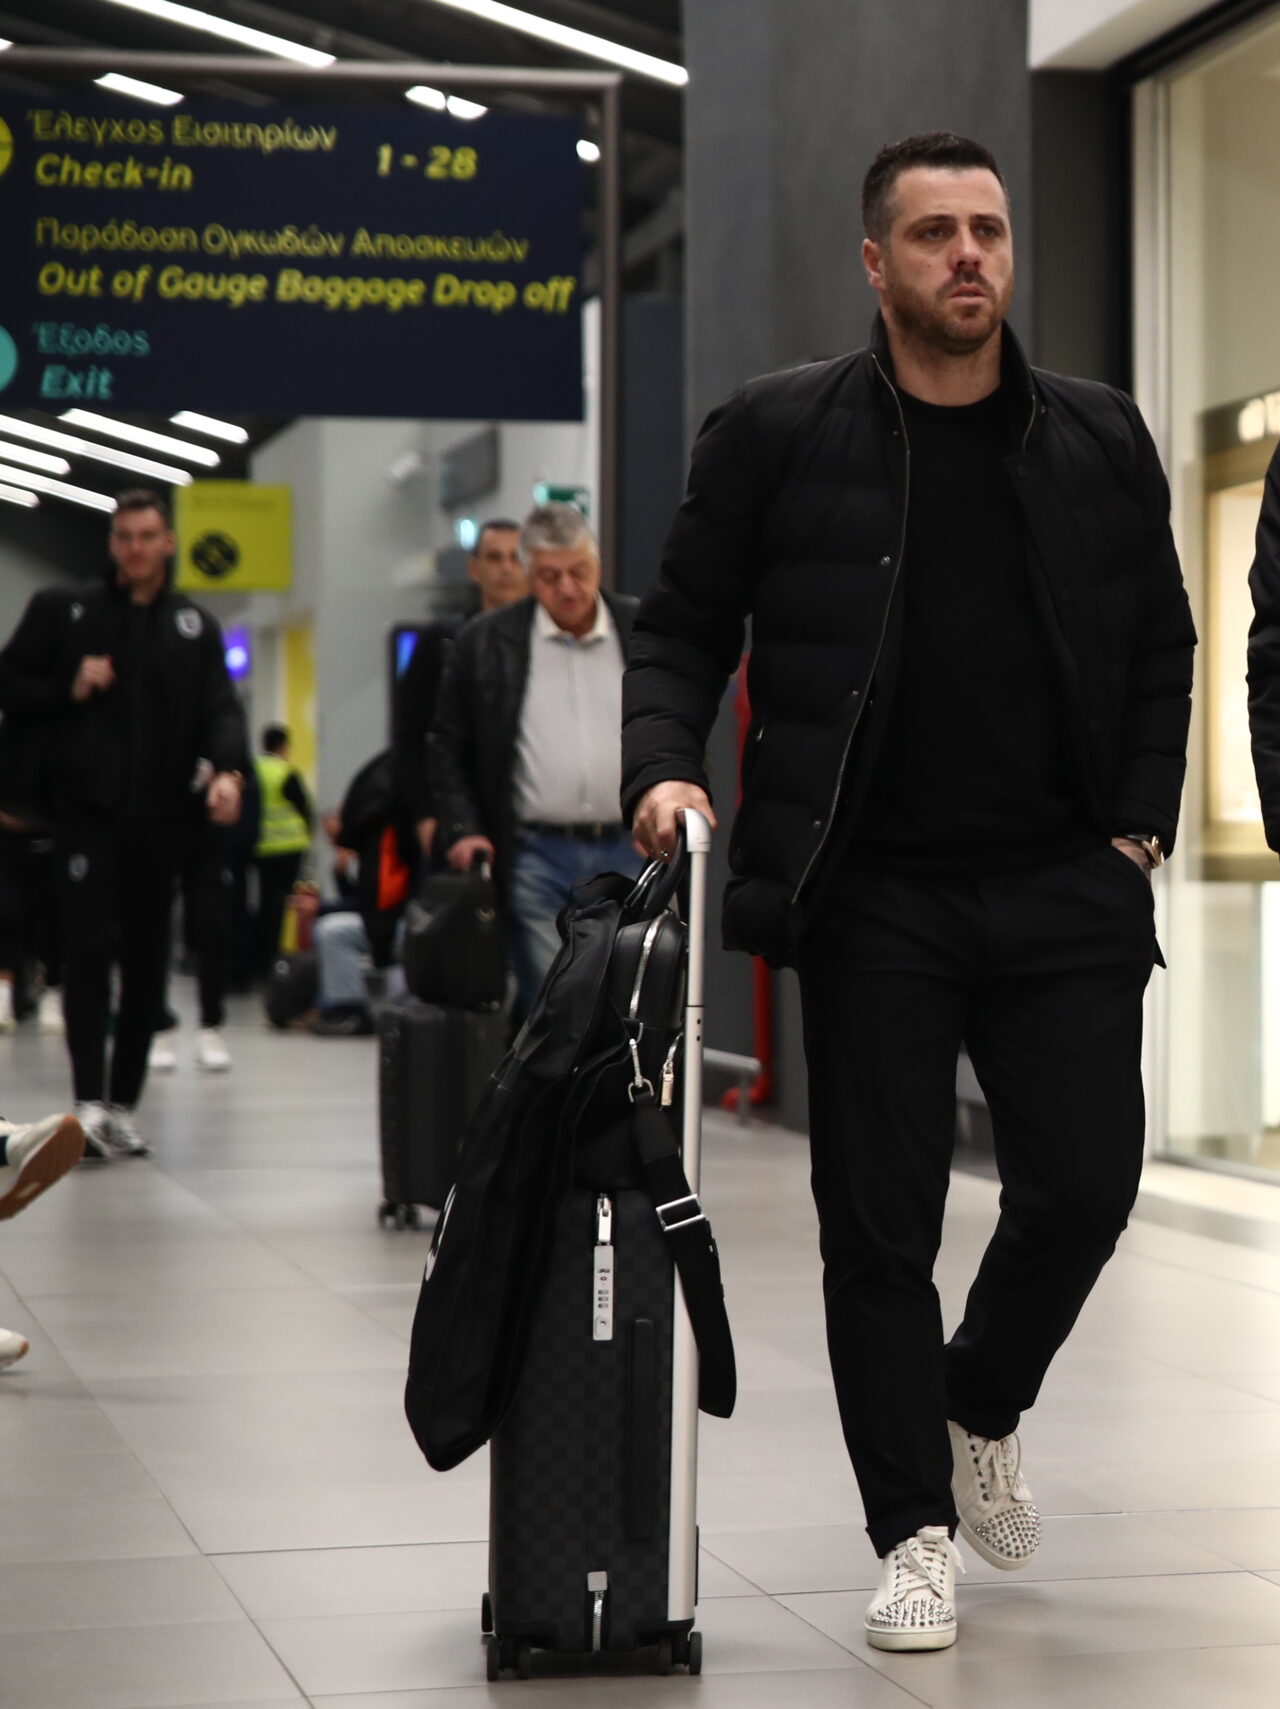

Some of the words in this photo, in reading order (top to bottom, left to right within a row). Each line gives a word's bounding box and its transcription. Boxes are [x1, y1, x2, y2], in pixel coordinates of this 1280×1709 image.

[29, 110, 165, 147] Έλεγχος
[172, 115, 338, 153] Εισιτηρίων
[35, 153, 194, 189] Check-in
[424, 145, 478, 180] 28
[36, 217, 199, 254] Παράδοση
[203, 222, 345, 260] Ογκωδών
[351, 227, 530, 263] Αποσκευών
[38, 262, 104, 296] Out
[111, 265, 152, 303] of
[158, 264, 269, 308] Gauge
[275, 267, 426, 312] Baggage
[432, 272, 517, 315] Drop
[523, 275, 576, 313] off
[32, 321, 151, 356] Έξοδος
[41, 363, 113, 399] Exit
